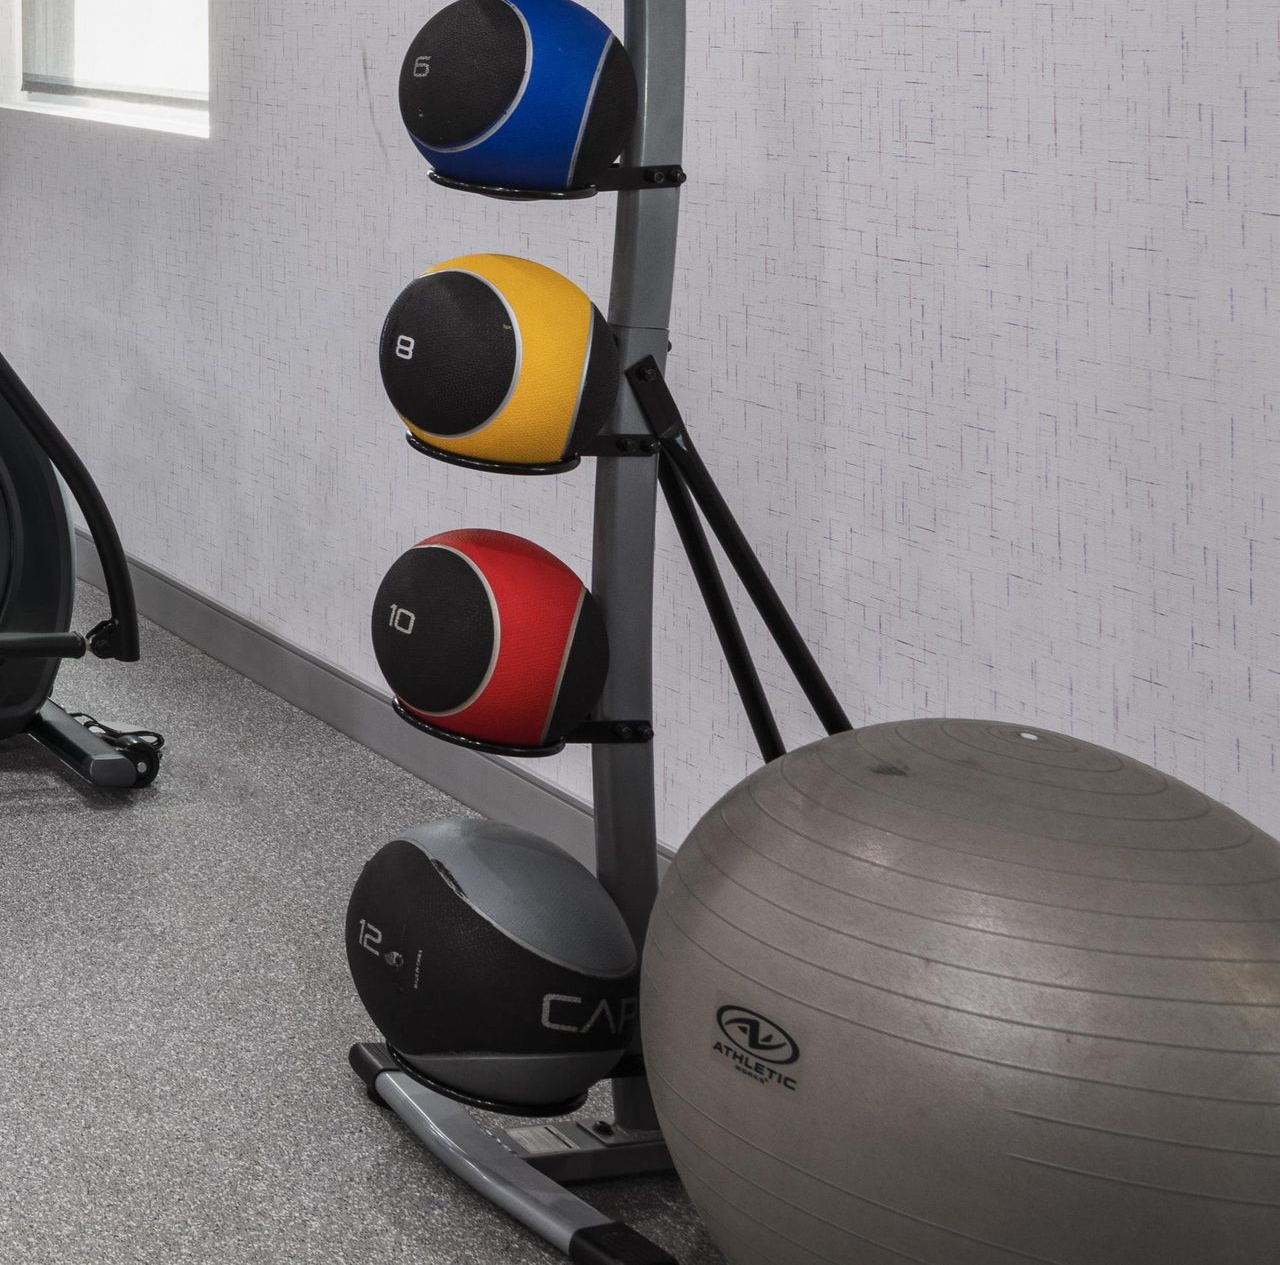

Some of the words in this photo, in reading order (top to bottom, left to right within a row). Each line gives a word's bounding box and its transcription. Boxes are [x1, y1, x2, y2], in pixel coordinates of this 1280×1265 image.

[413, 55, 432, 78] 6
[395, 335, 415, 360] 8
[388, 603, 416, 635] 10
[358, 918, 383, 957] 12
[712, 1041, 798, 1092] ATHLETIC
